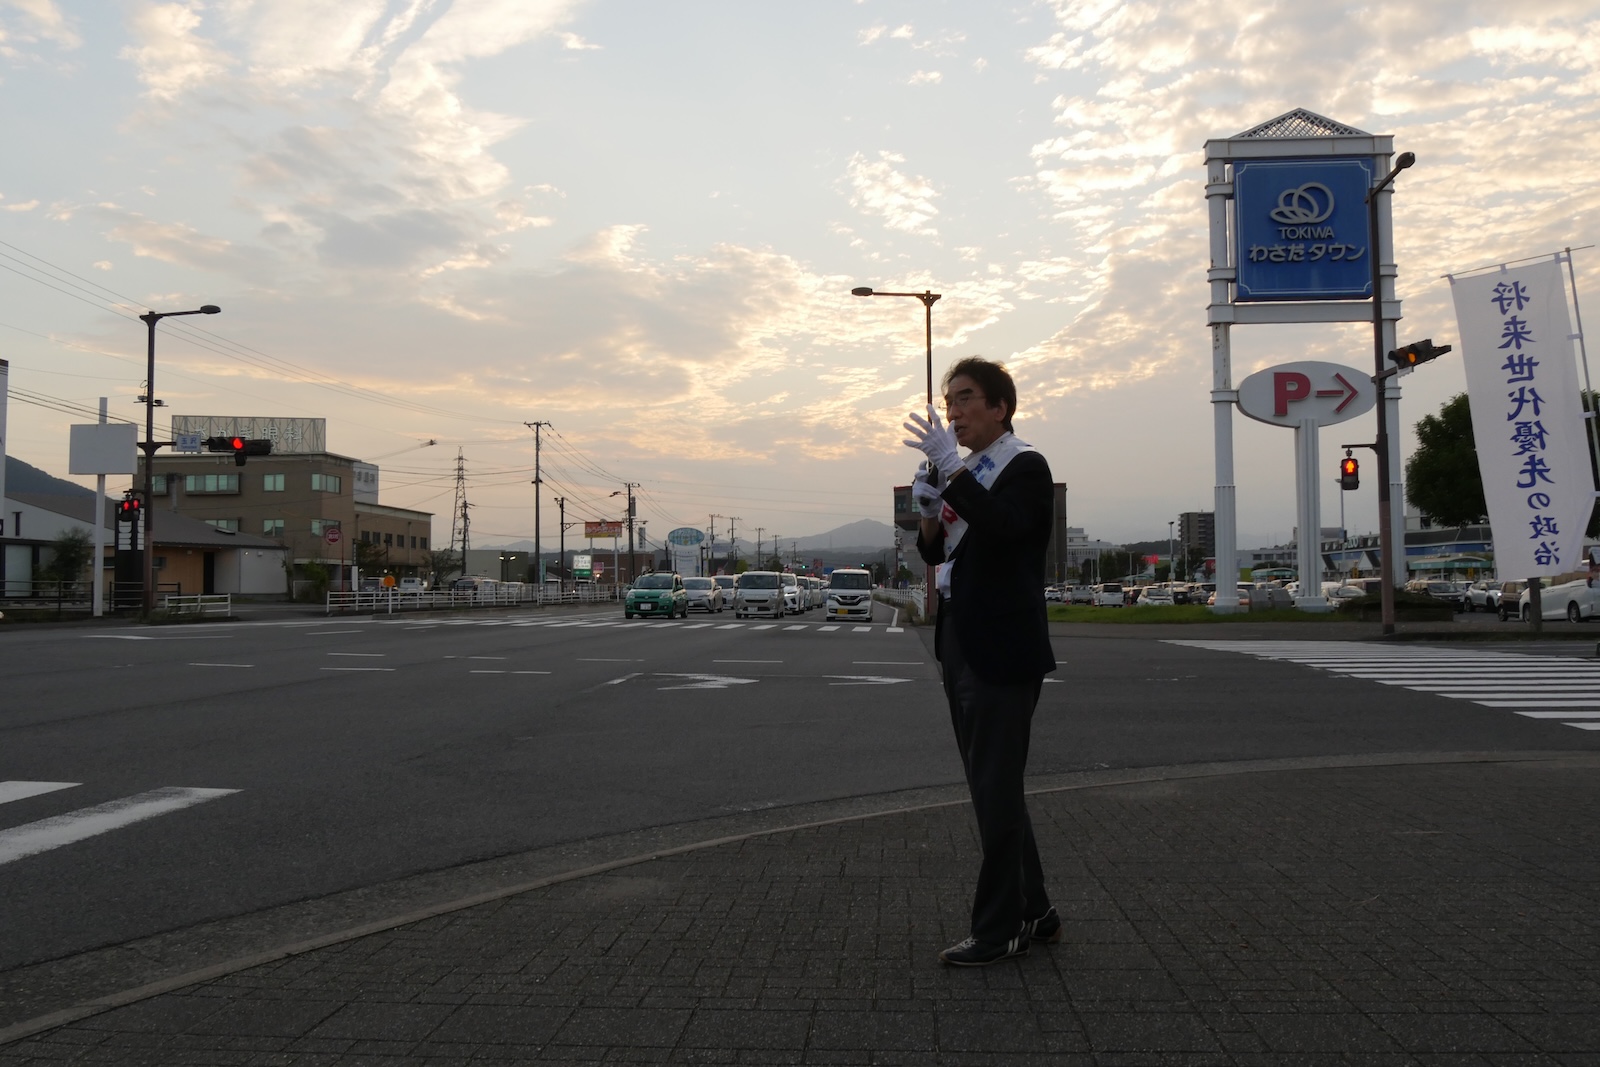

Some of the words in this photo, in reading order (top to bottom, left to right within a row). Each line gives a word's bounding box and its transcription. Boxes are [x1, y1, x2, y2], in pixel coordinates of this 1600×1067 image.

[1278, 226, 1335, 240] TOKIWA
[1248, 243, 1364, 262] わさだタウン
[1273, 372, 1311, 416] P
